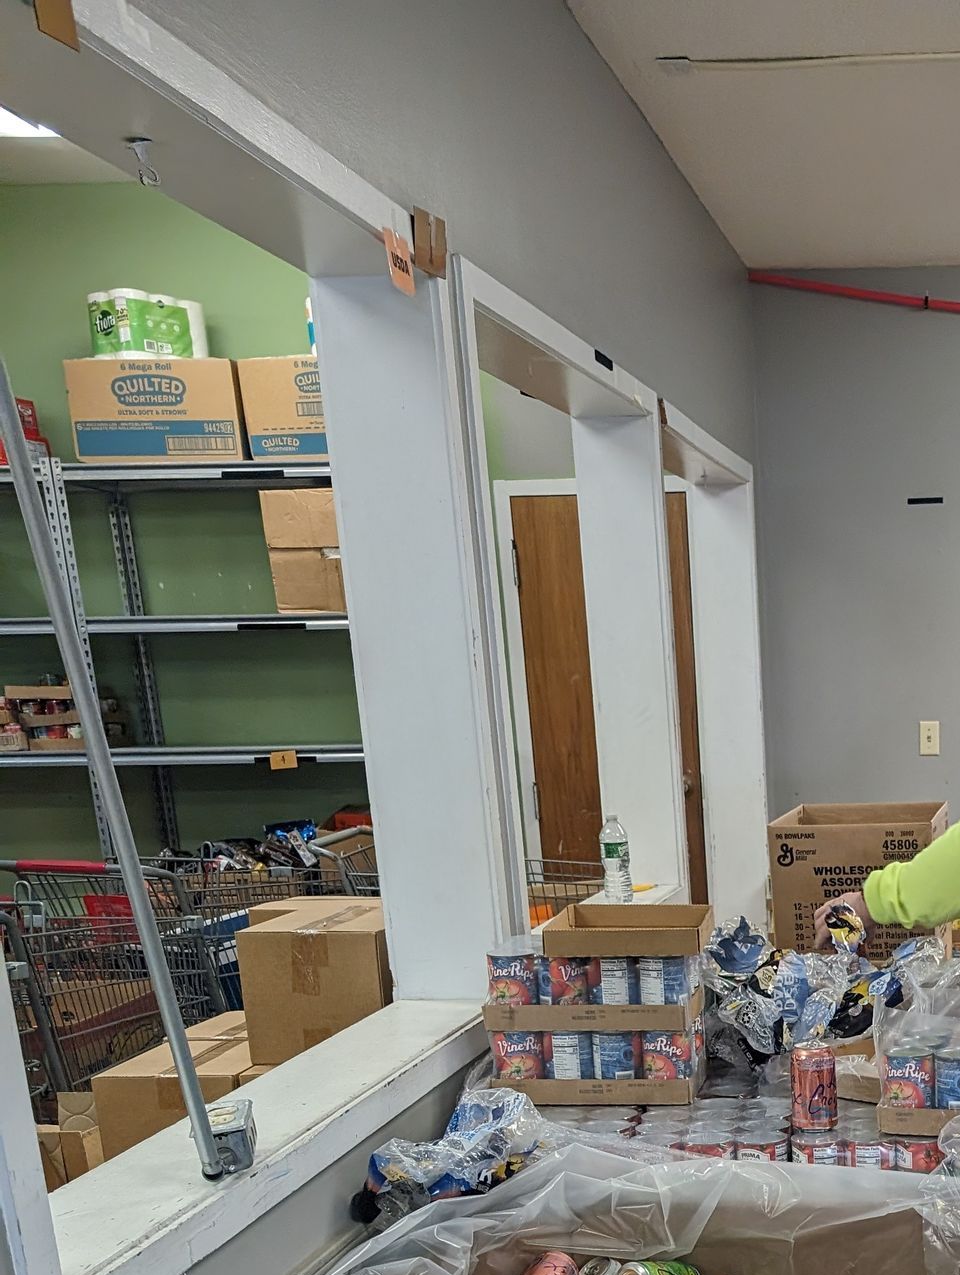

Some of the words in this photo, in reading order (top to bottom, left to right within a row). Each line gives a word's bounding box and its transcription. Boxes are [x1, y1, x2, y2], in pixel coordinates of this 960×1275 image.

[95, 312, 116, 334] fiora
[128, 363, 152, 372] Mega
[154, 363, 172, 371] Roll
[301, 361, 319, 369] Meg
[114, 379, 185, 396] QUILTED
[296, 375, 320, 388] QUIL
[125, 394, 176, 404] NORTHERN
[261, 436, 300, 448] QUILTED
[784, 832, 815, 840] BOWLPAKS
[882, 839, 919, 851] 45806
[813, 866, 884, 876] WHOLESOM
[886, 931, 908, 940] Raisin
[498, 1039, 523, 1056] Vine
[656, 1037, 683, 1056] Ripe
[902, 1063, 931, 1081] Ripe
